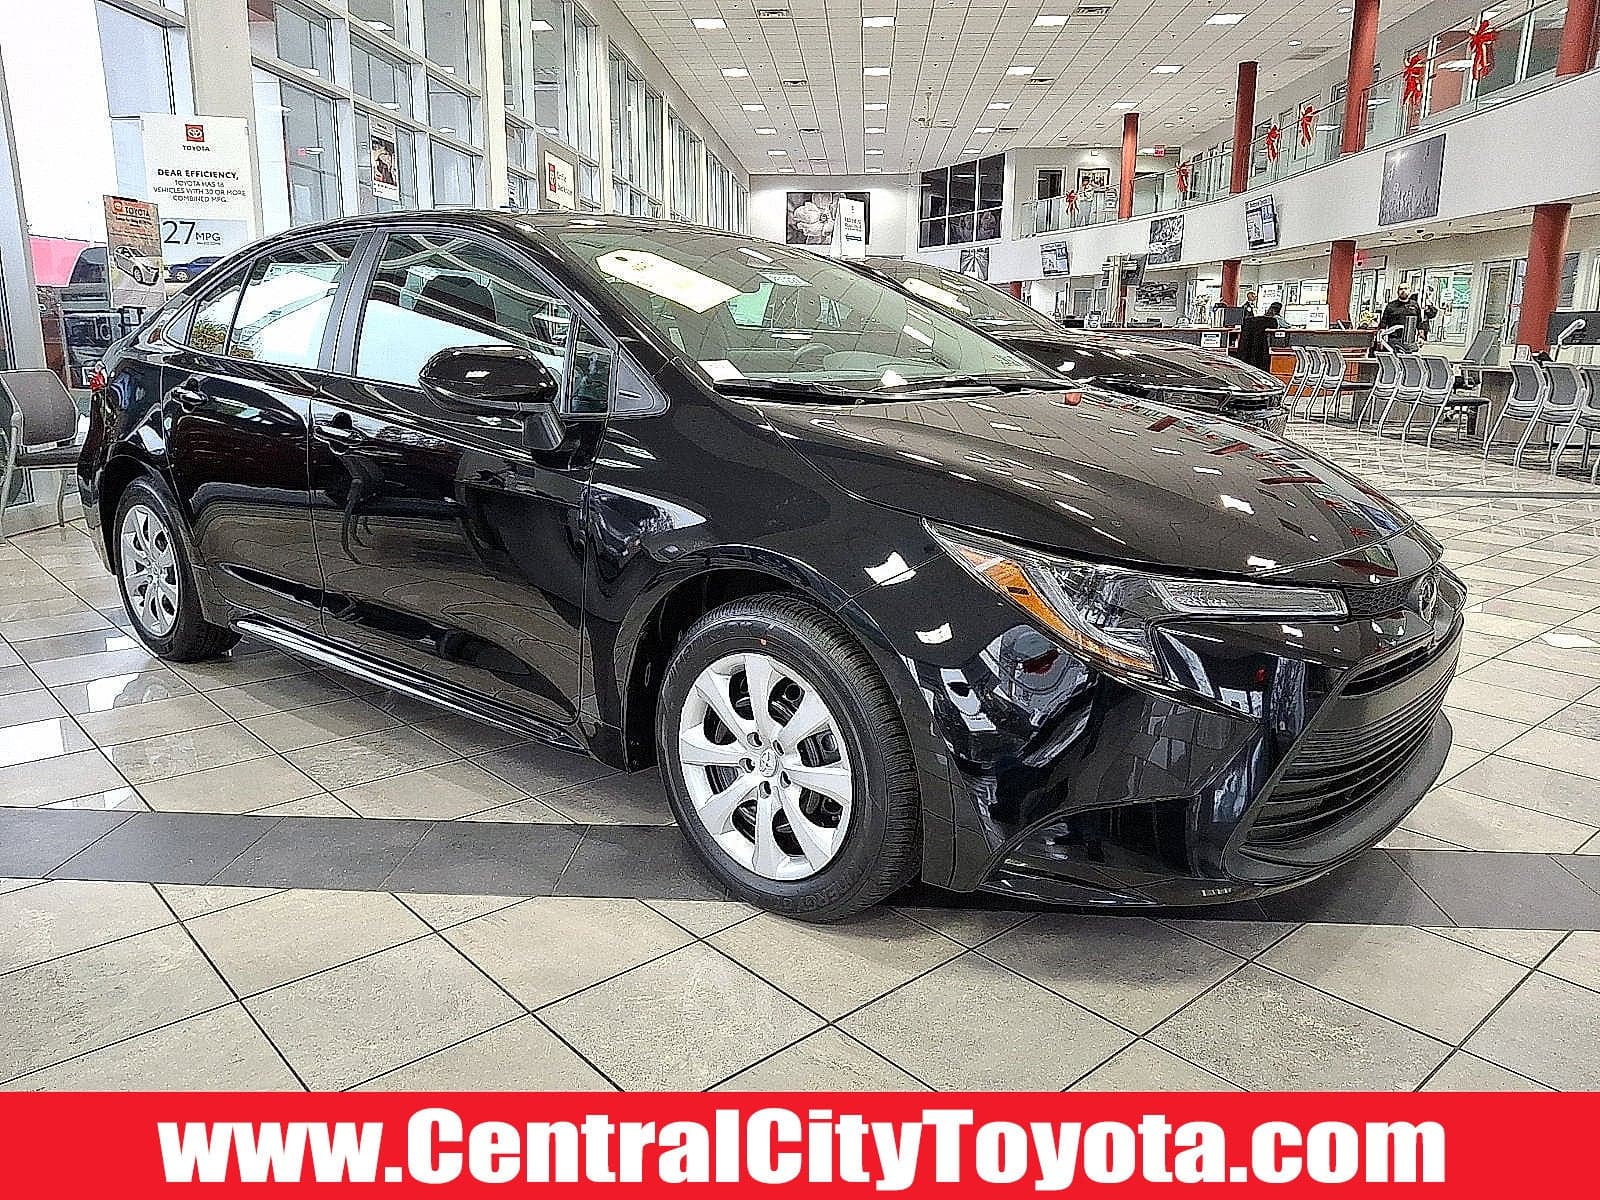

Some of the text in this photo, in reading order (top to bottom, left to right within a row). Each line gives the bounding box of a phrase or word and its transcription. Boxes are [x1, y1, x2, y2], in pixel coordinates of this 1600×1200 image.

[182, 144, 211, 152] TOYOTA
[157, 168, 239, 180] DEAR EFFICIENCY,
[227, 189, 247, 197] MORE
[125, 206, 151, 217] TOYOTA
[163, 220, 195, 244] 27
[196, 231, 221, 241] MPG
